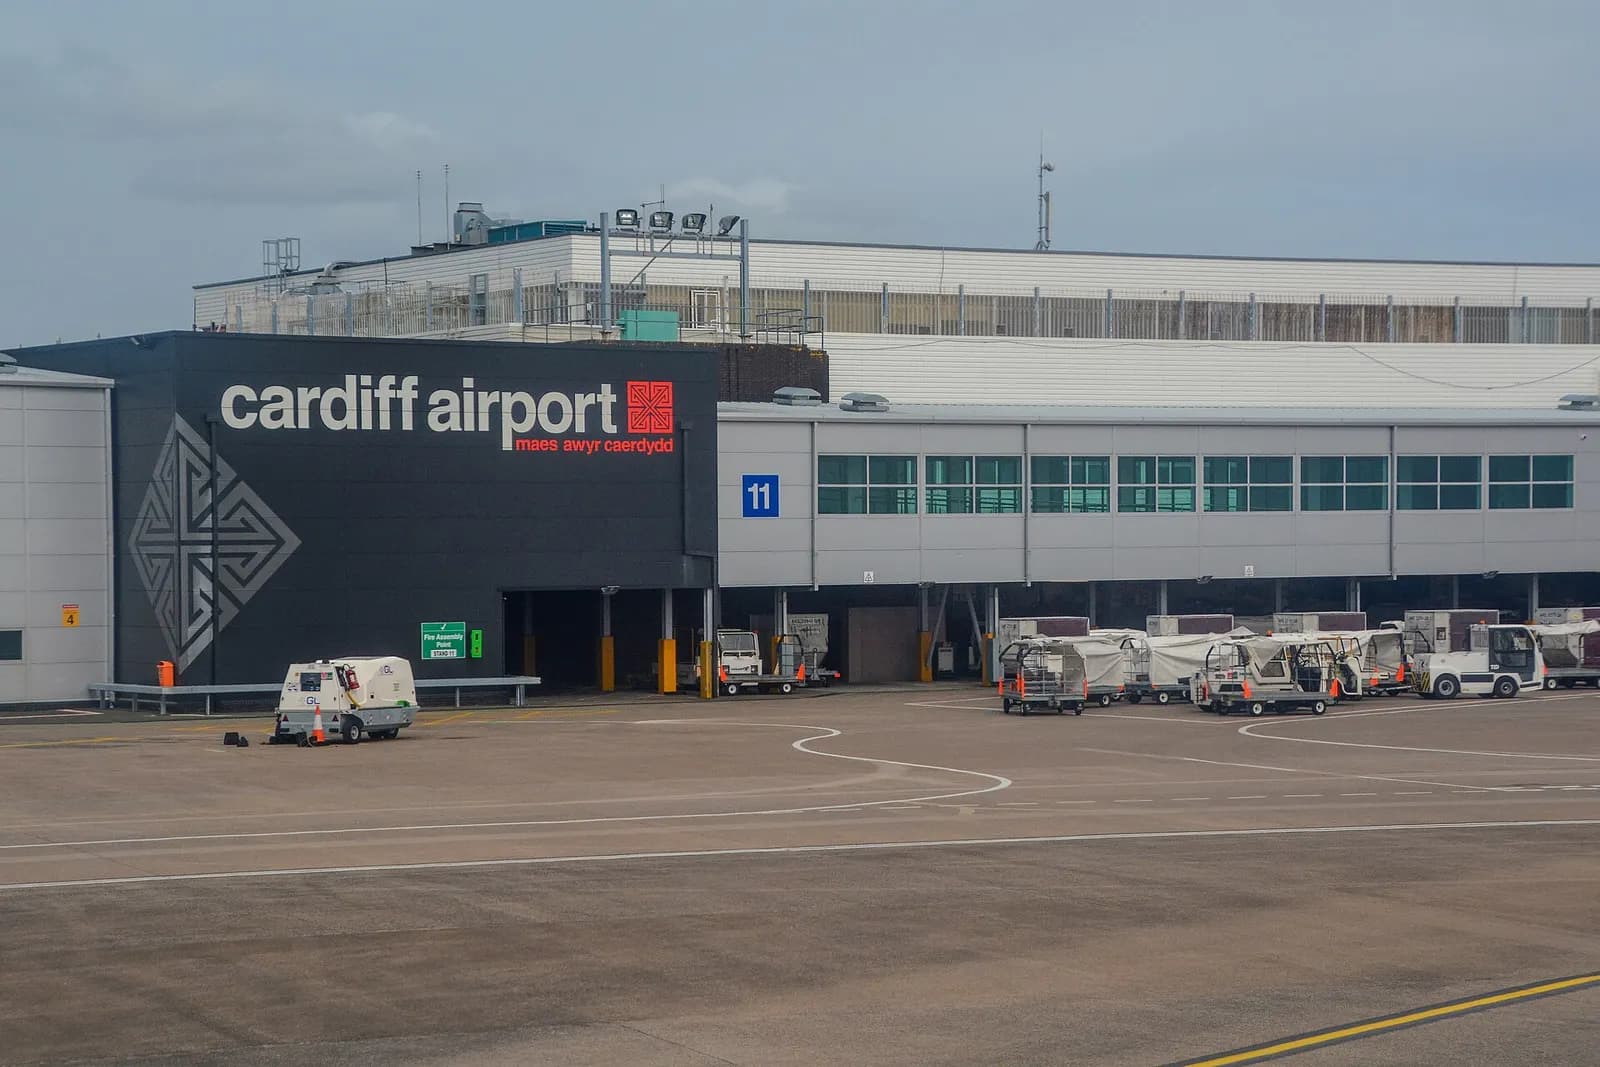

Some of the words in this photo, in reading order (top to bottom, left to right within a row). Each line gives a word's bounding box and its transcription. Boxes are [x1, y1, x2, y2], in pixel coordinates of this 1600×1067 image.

[221, 374, 419, 431] cardiff
[427, 377, 617, 451] airport
[515, 438, 559, 452] maes
[563, 439, 601, 455] awyr
[604, 438, 675, 455] caerdydd
[747, 482, 770, 510] 11
[66, 614, 74, 625] 4
[436, 633, 464, 641] Assembly
[306, 696, 320, 705] GL
